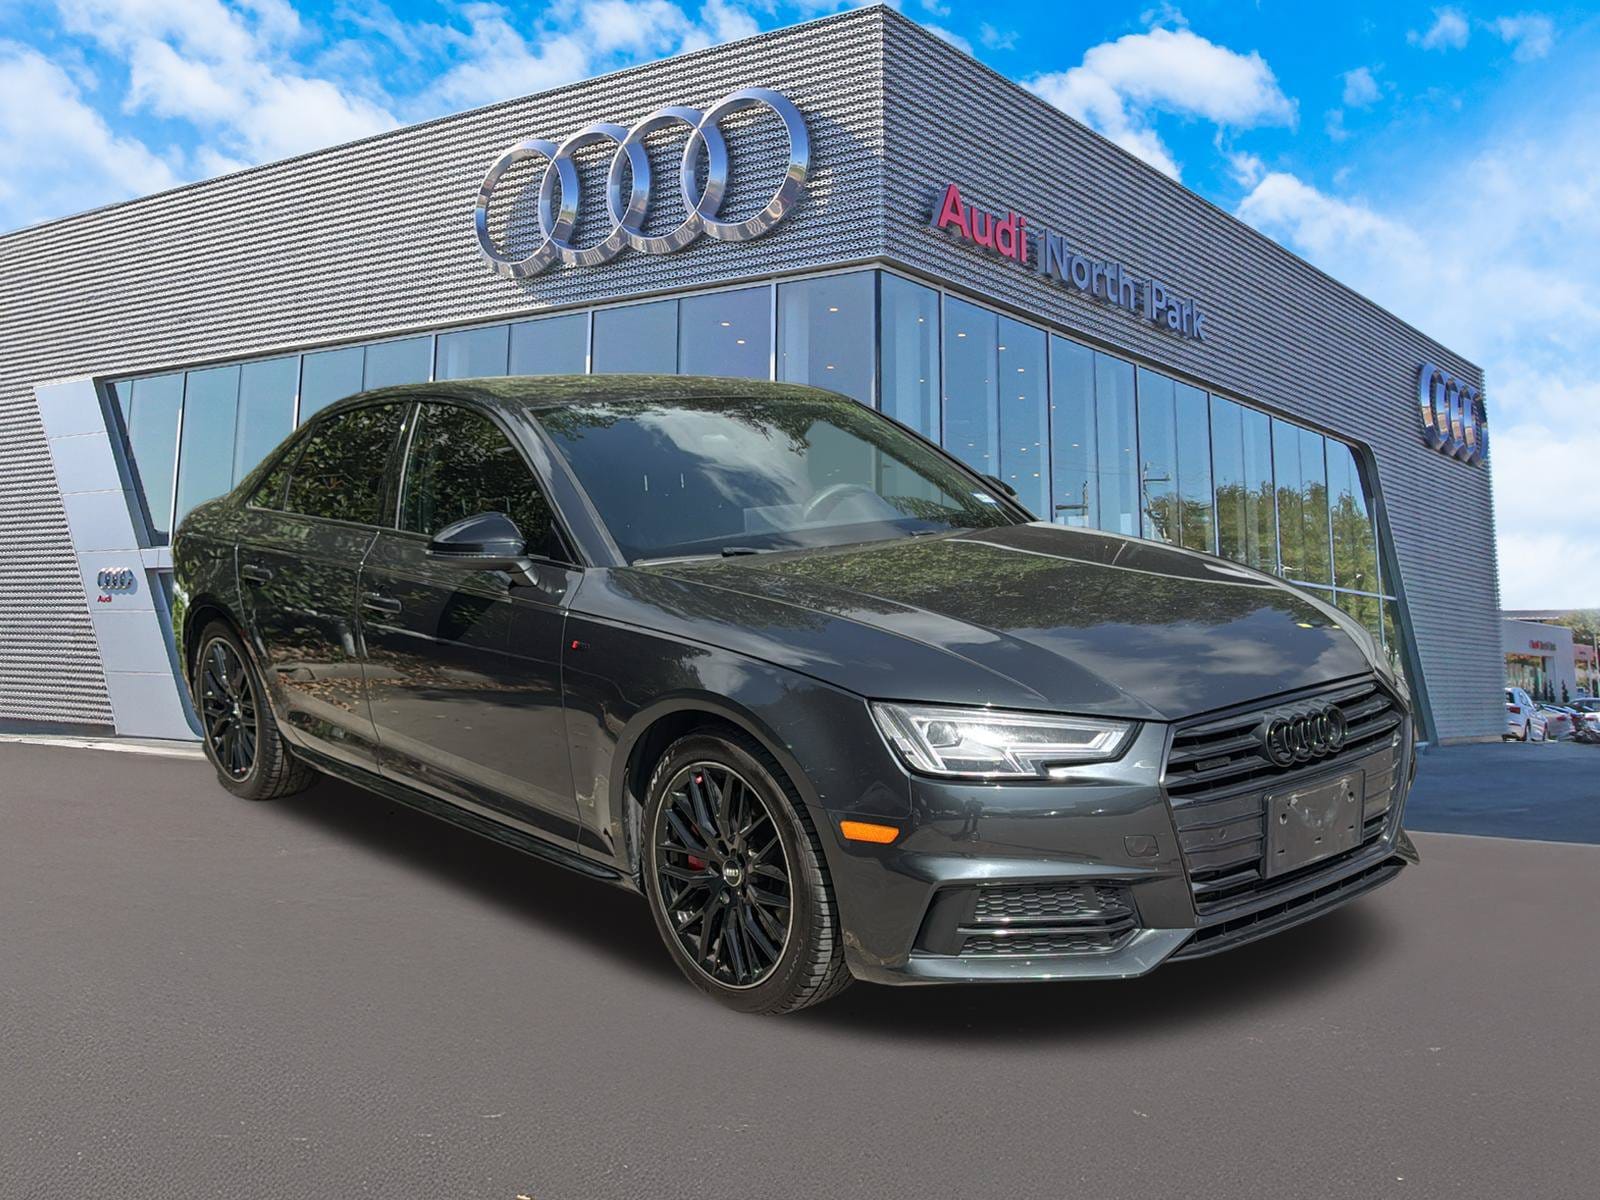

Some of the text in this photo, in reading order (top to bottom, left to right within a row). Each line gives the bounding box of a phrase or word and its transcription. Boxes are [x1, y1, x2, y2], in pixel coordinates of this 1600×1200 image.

[936, 183, 1207, 341] Audi North Park
